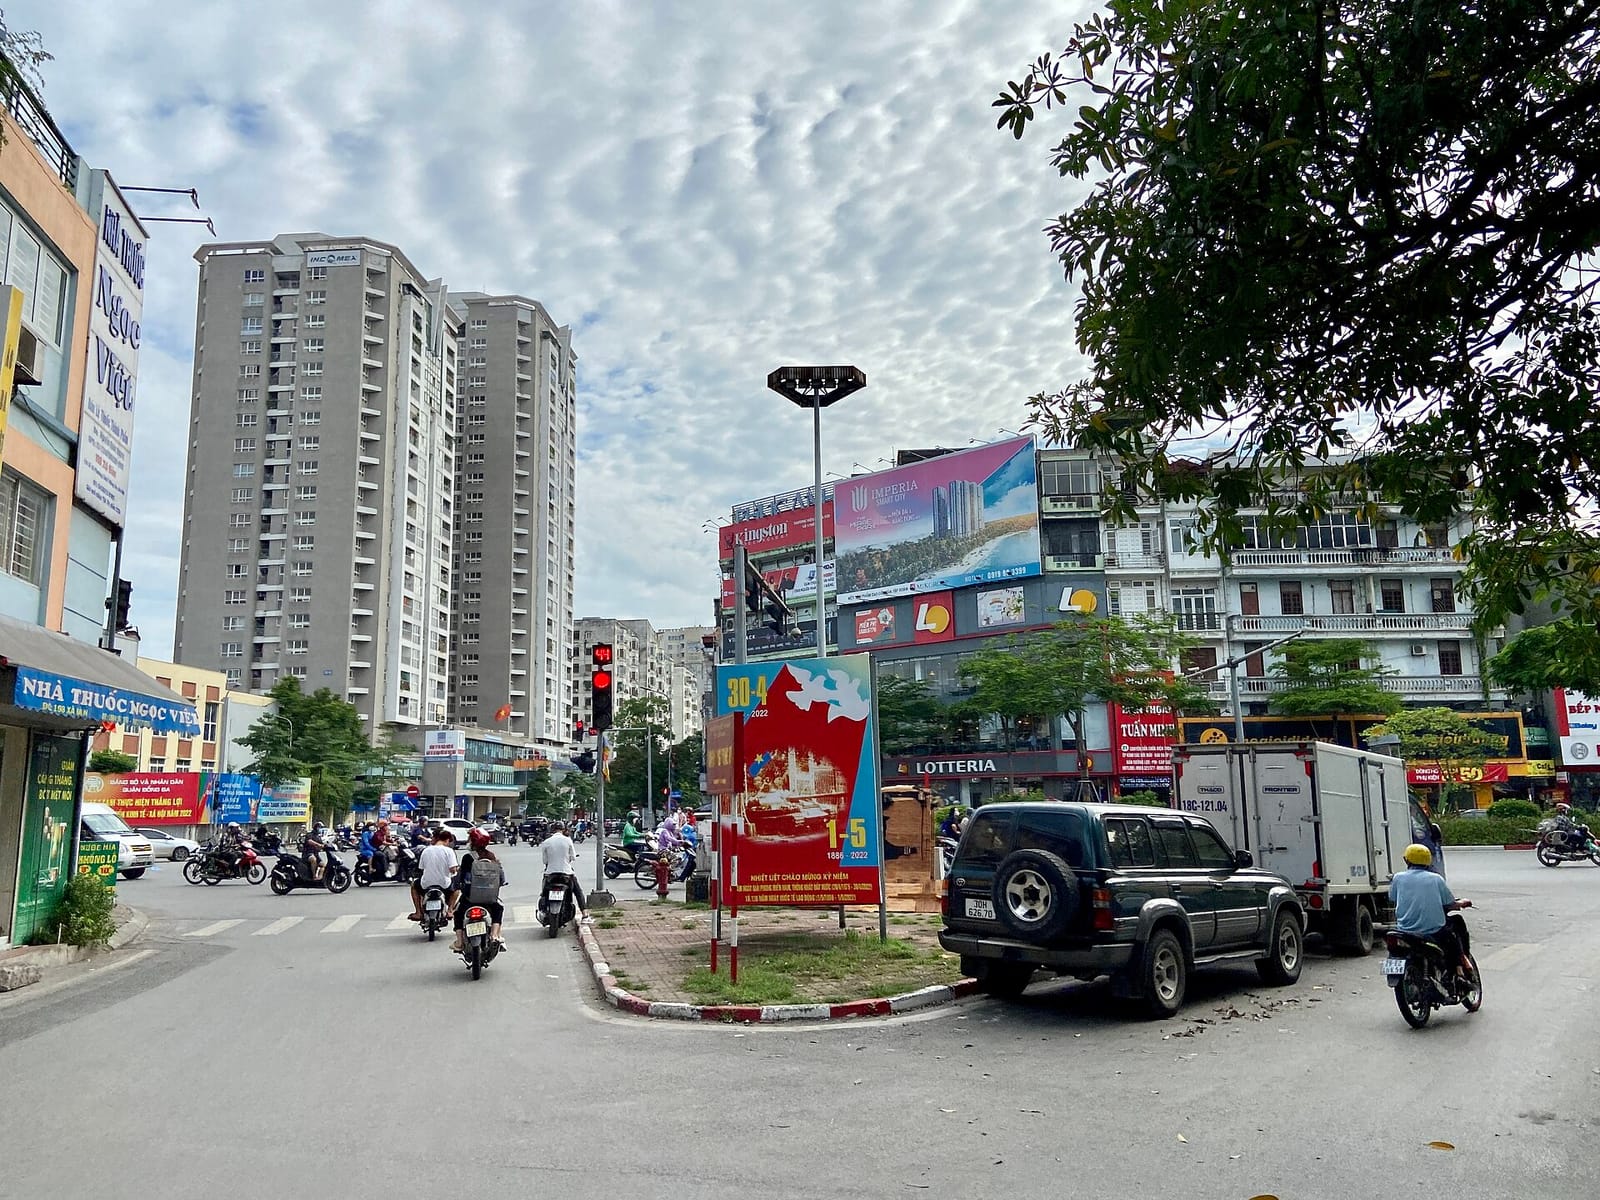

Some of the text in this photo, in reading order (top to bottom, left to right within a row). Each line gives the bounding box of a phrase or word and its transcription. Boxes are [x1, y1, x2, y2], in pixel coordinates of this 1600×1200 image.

[96, 264, 140, 350] Ngọc
[96, 335, 133, 411] Việt
[871, 480, 918, 500] IMPERIA
[894, 493, 906, 502] CITY
[735, 522, 788, 544] Kingston
[595, 648, 610, 661] 44
[727, 675, 768, 708] 30-4
[23, 676, 64, 702] NHÀ
[71, 689, 127, 713] THUỐC
[129, 700, 166, 721] NGỌC
[169, 707, 200, 727] VIỆT
[1568, 701, 1591, 714] BẾP
[751, 709, 768, 718] 2022
[1120, 719, 1148, 738] TUẤN
[916, 759, 996, 774] LOTTERIA
[826, 818, 866, 849] 1-5
[850, 851, 868, 859] 2022
[968, 908, 993, 918] 626.70
